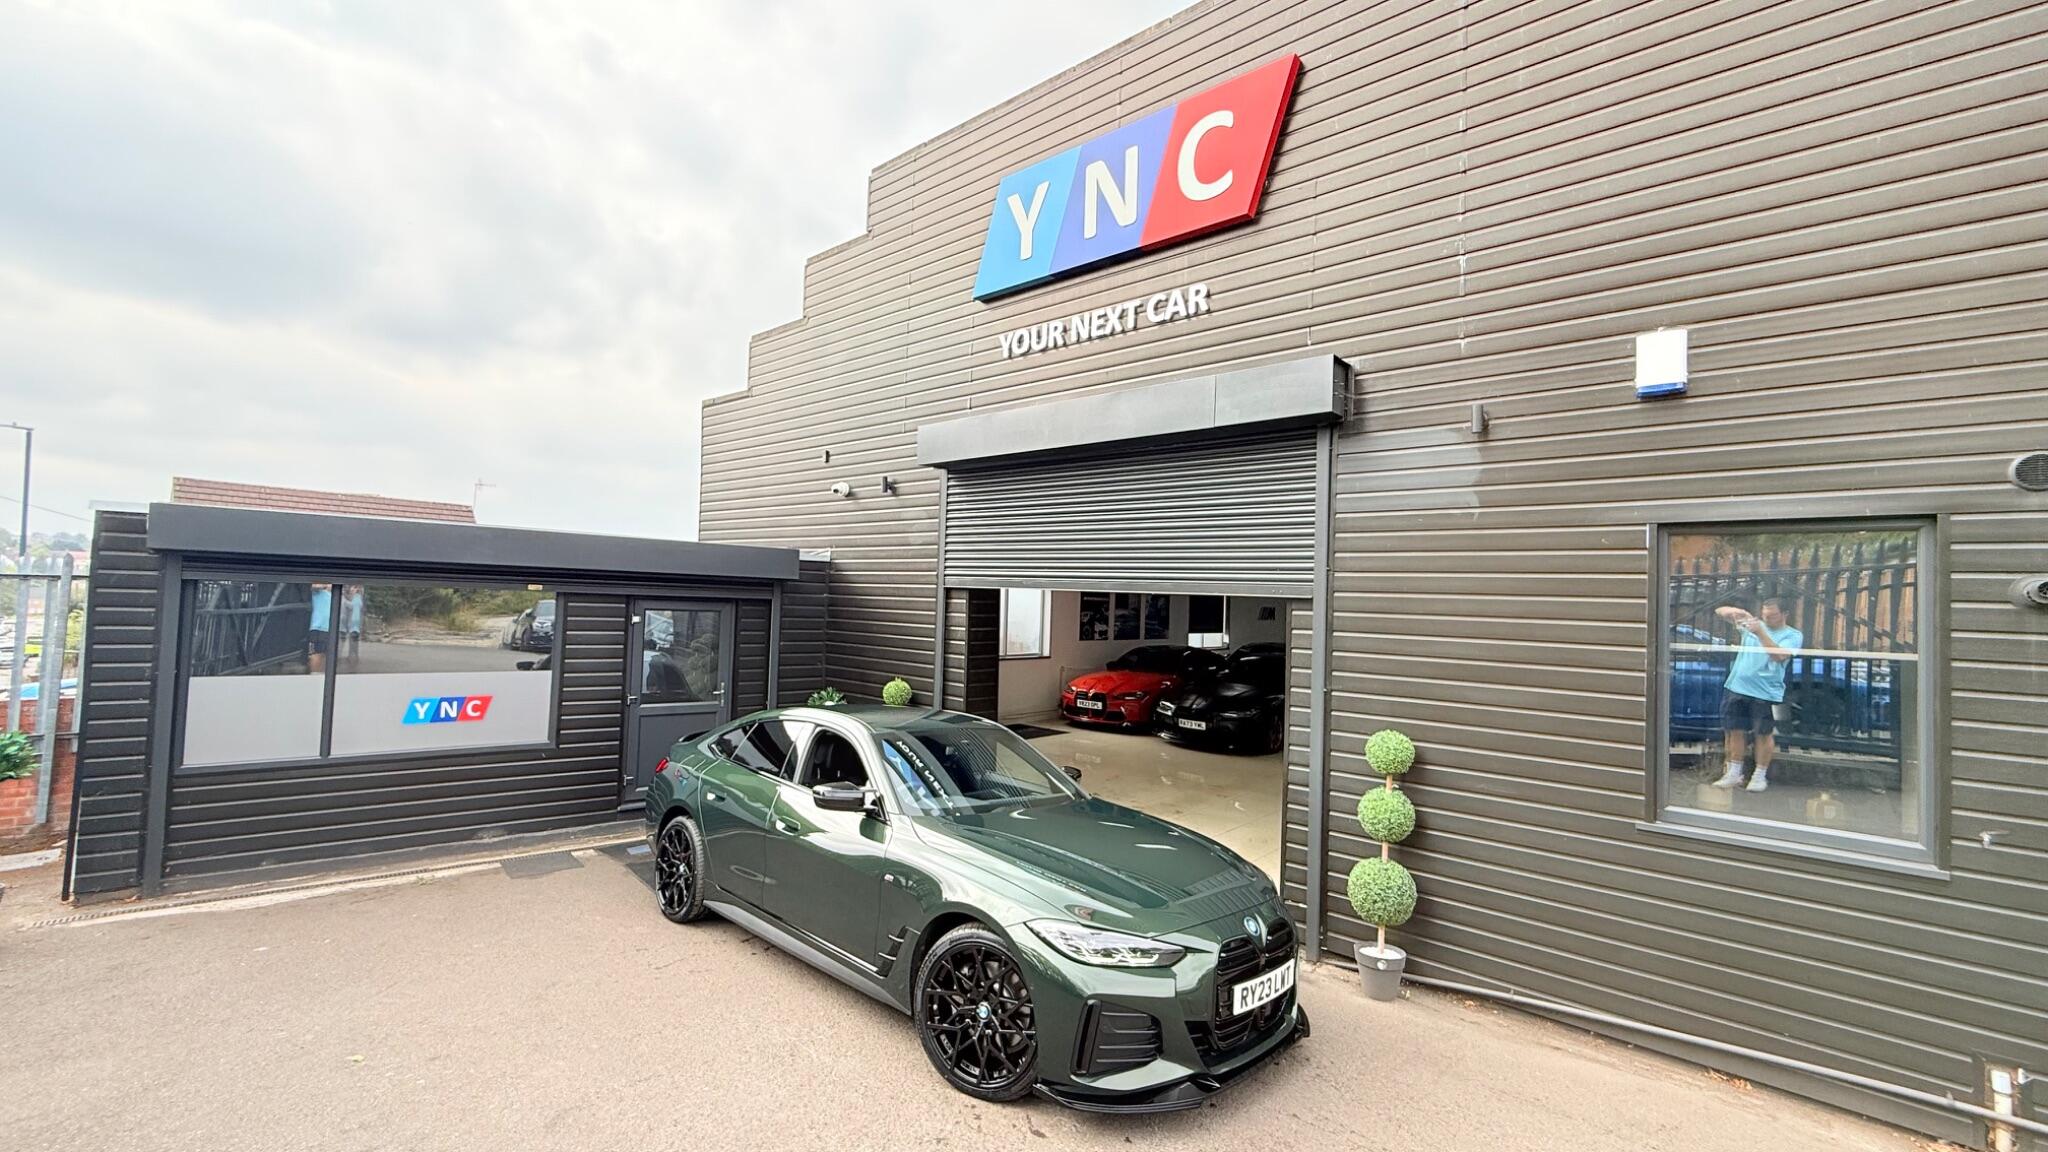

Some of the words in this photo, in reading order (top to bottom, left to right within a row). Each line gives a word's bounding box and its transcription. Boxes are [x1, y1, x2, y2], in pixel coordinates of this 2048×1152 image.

[1007, 110, 1234, 260] YNC
[1000, 319, 1064, 358] YOUR
[1070, 299, 1142, 339] NEXT
[1146, 283, 1210, 323] CAR
[414, 700, 482, 719] YNC
[1240, 977, 1273, 1009] RY23
[1274, 965, 1291, 993] LWT
